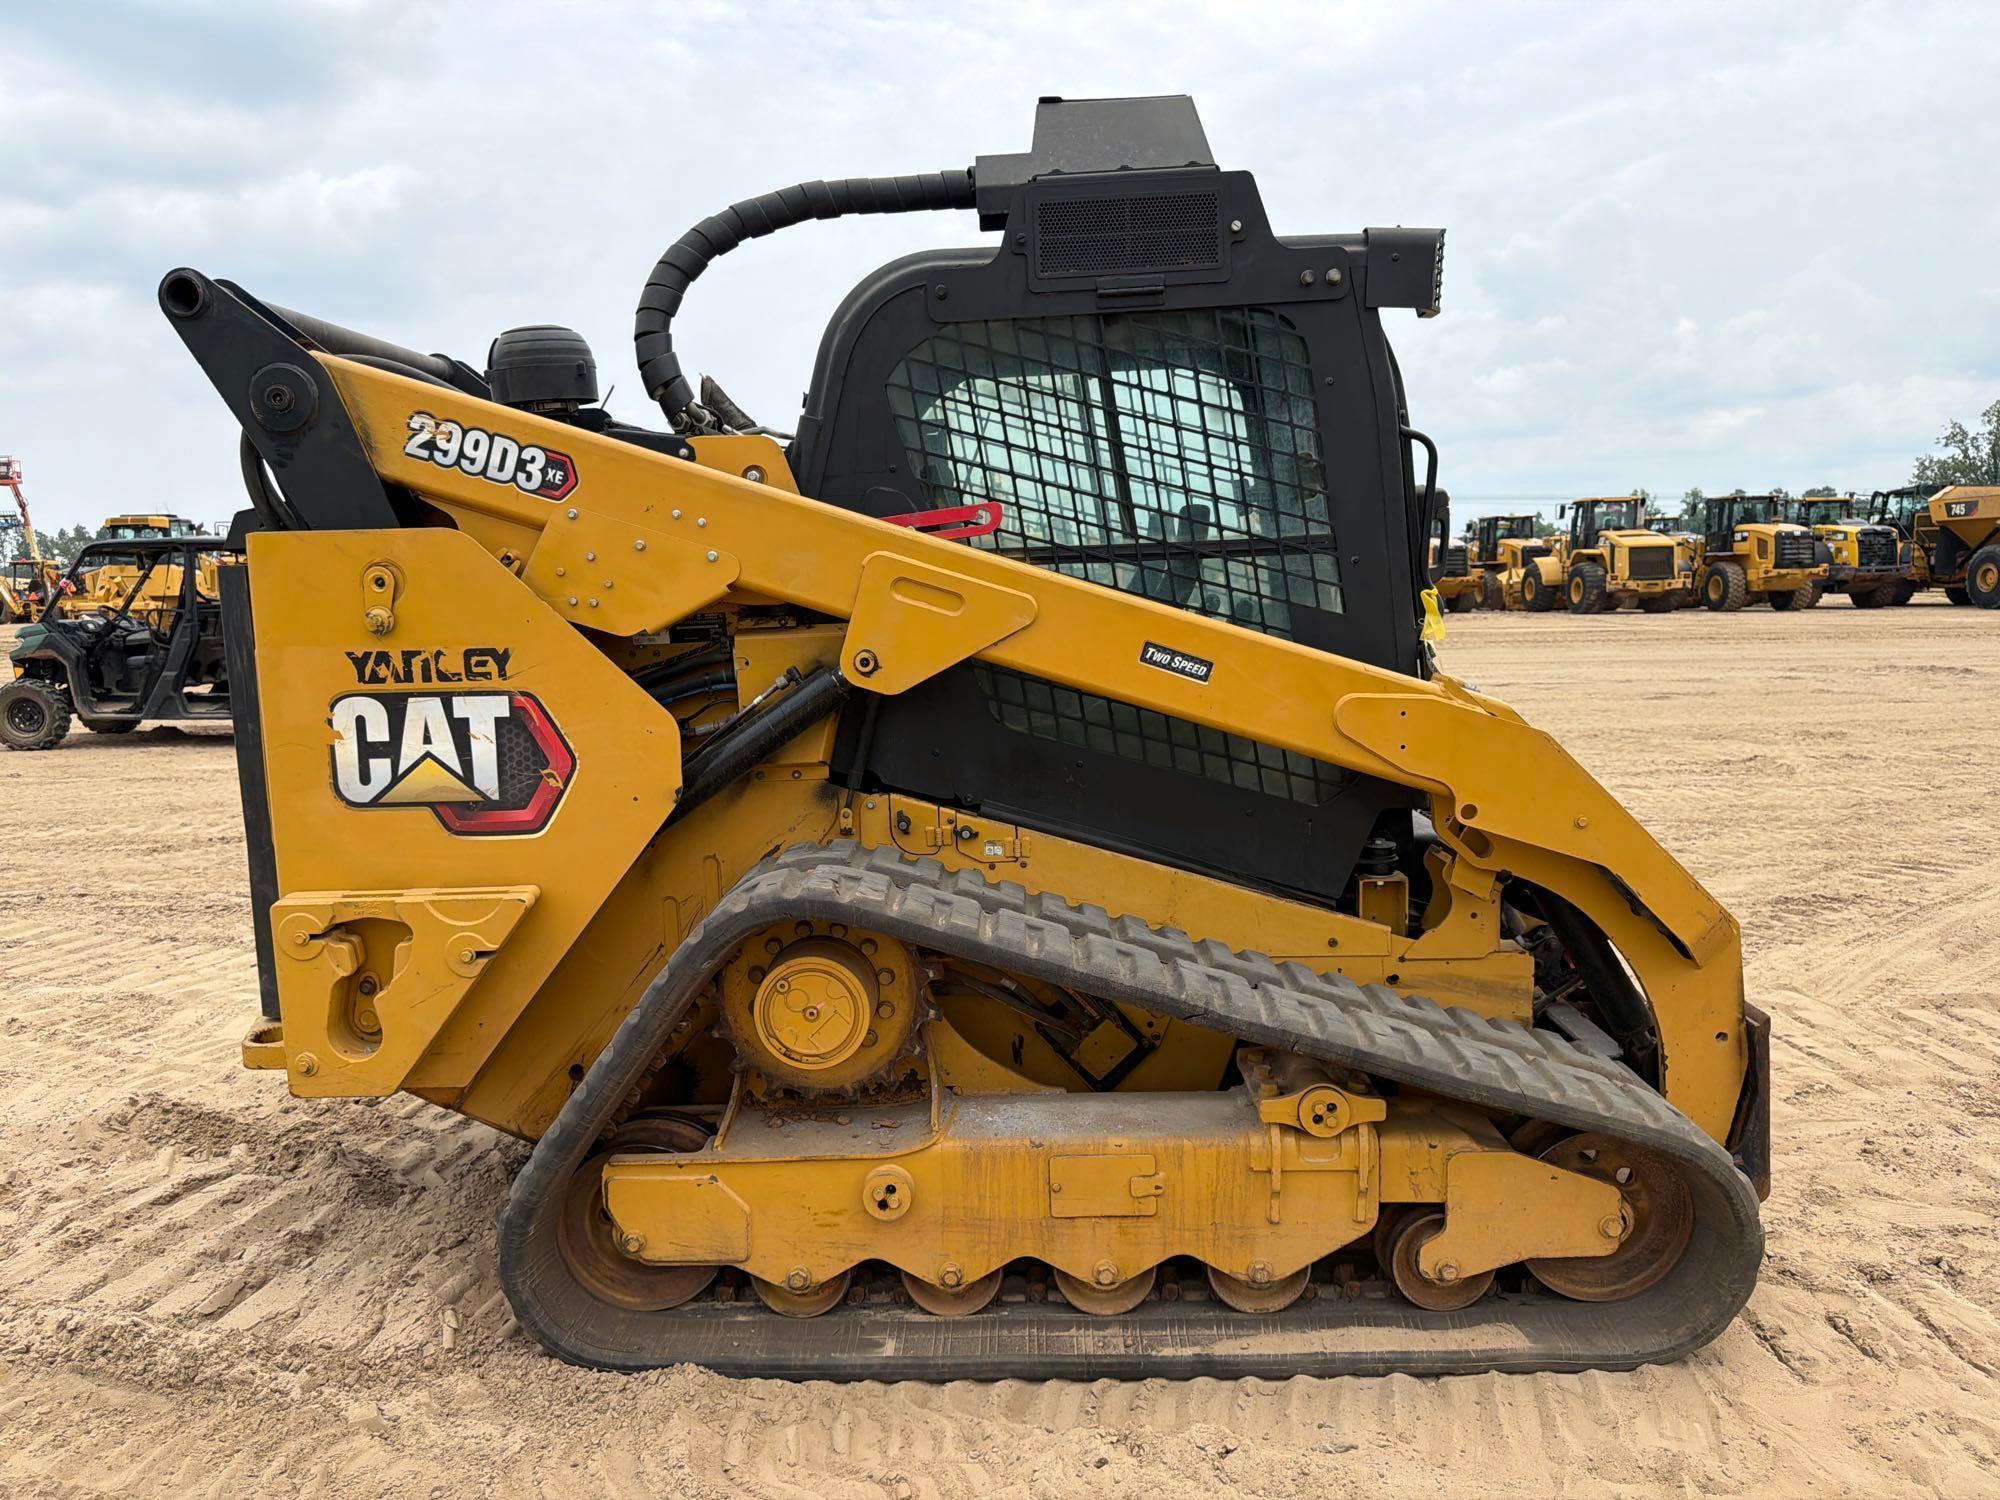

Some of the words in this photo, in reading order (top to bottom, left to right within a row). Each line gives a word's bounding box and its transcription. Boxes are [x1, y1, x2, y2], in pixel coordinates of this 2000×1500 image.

[405, 413, 546, 491] 299D3
[546, 467, 564, 485] XE
[1951, 503, 1966, 516] 745
[332, 696, 510, 803] CAT
